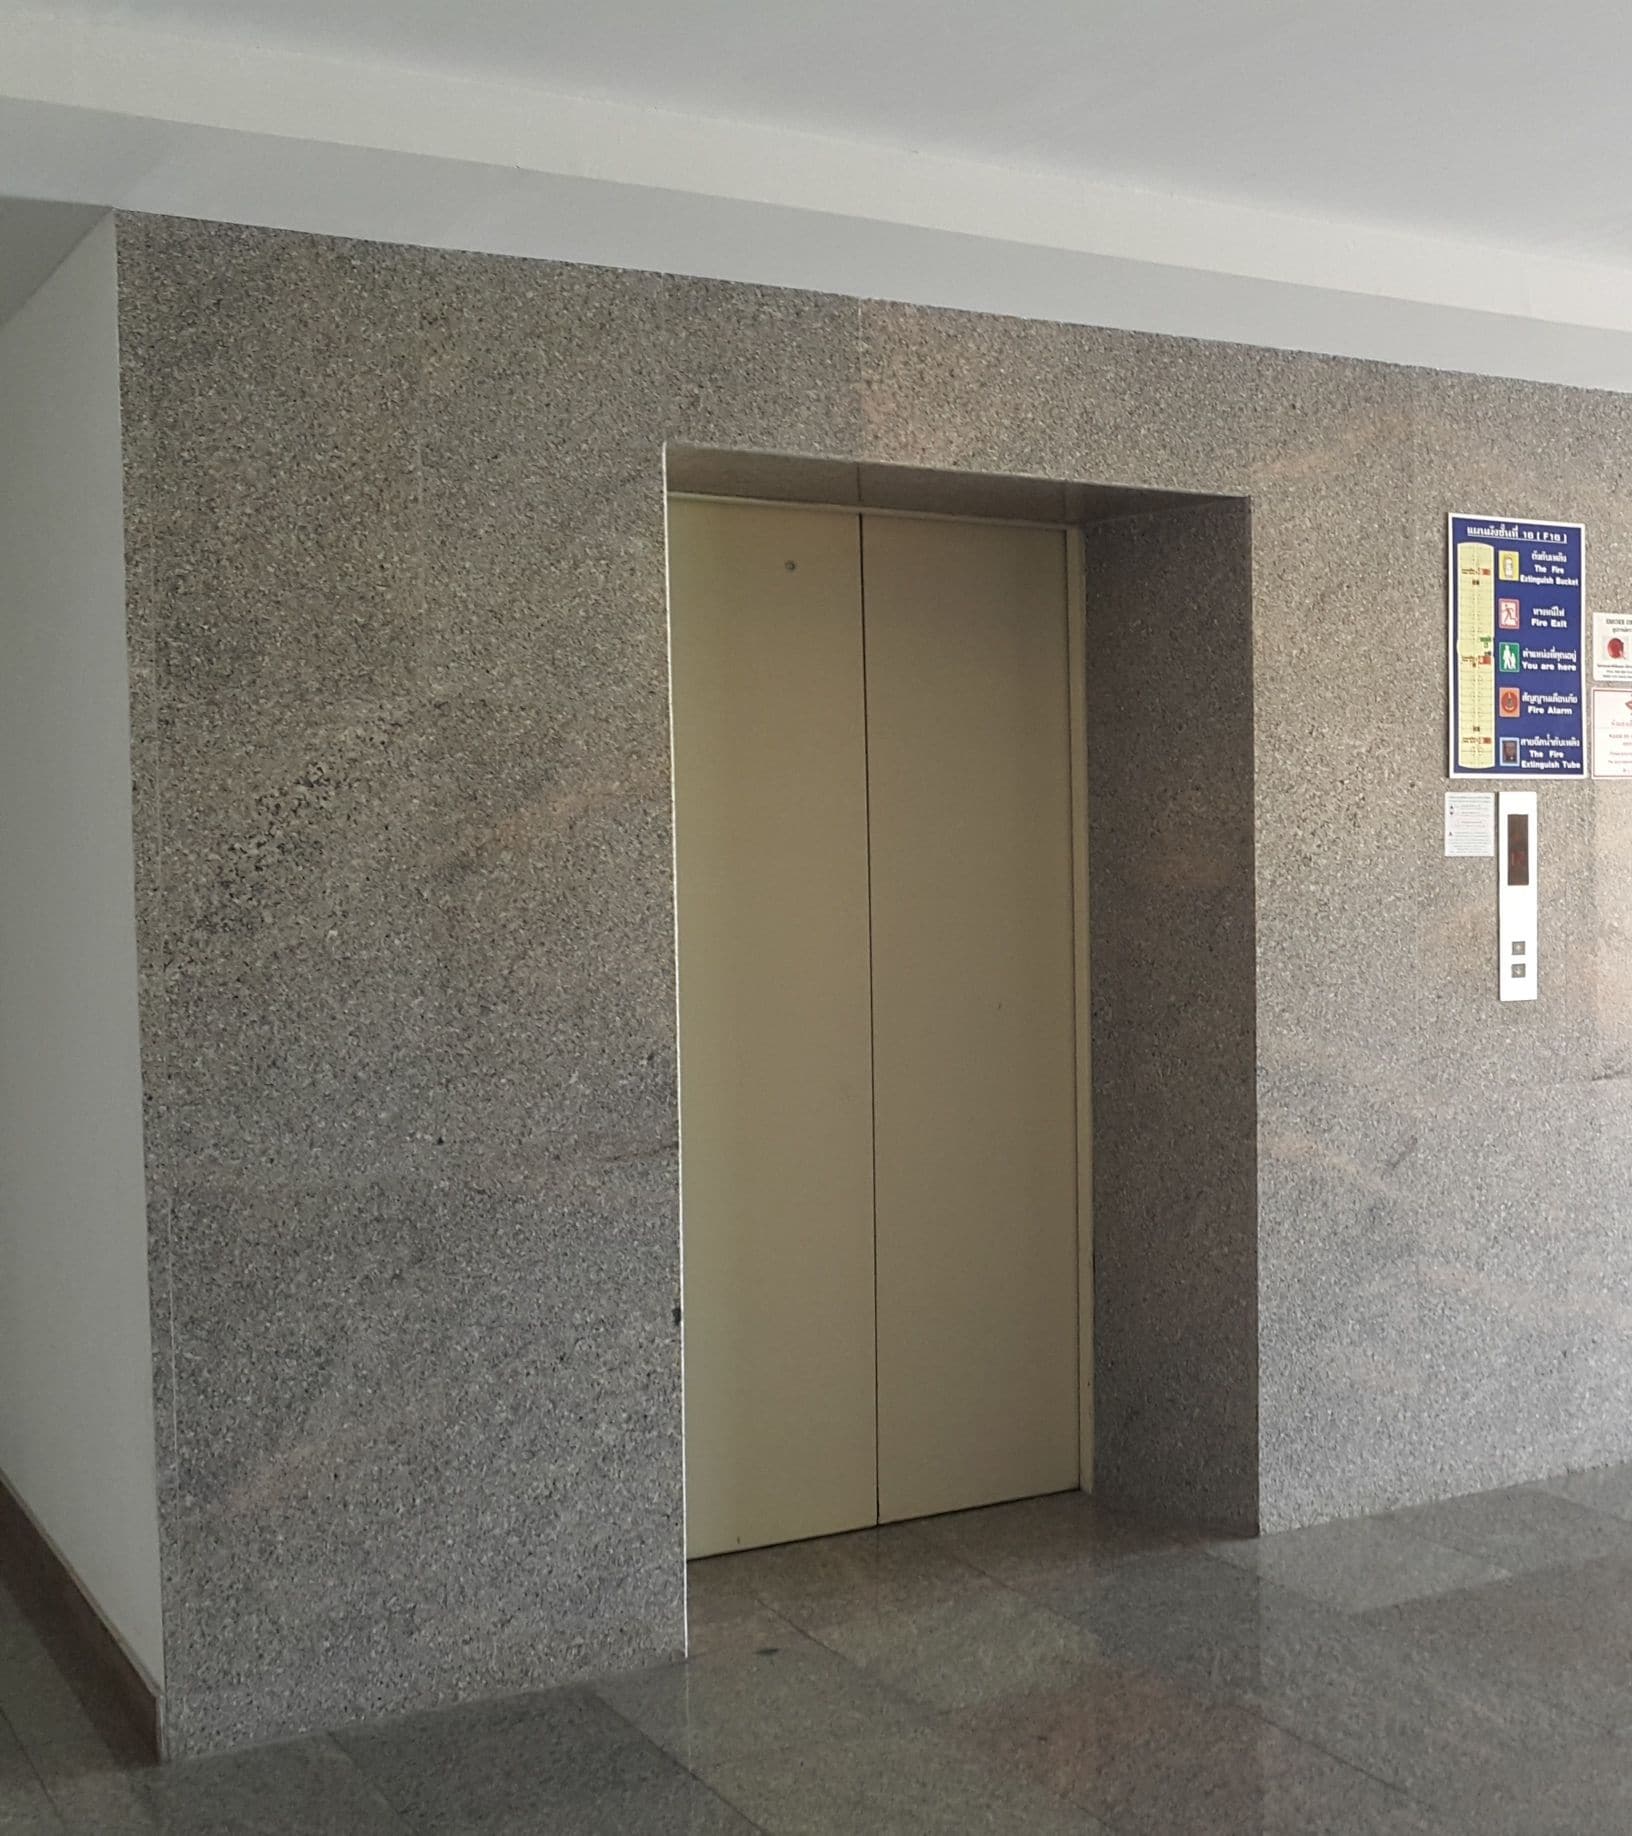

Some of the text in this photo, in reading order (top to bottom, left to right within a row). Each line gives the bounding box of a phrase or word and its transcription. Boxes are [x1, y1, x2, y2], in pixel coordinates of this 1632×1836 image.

[1534, 565, 1564, 574] The Fire
[1520, 575, 1579, 586] Extinguish Bucket
[1531, 618, 1568, 628] Fire Exit
[1522, 661, 1577, 671] You are here
[1527, 706, 1573, 715] Fire Alarm
[1529, 750, 1564, 758] The Fire
[1521, 761, 1581, 770] Extinguish Tube
